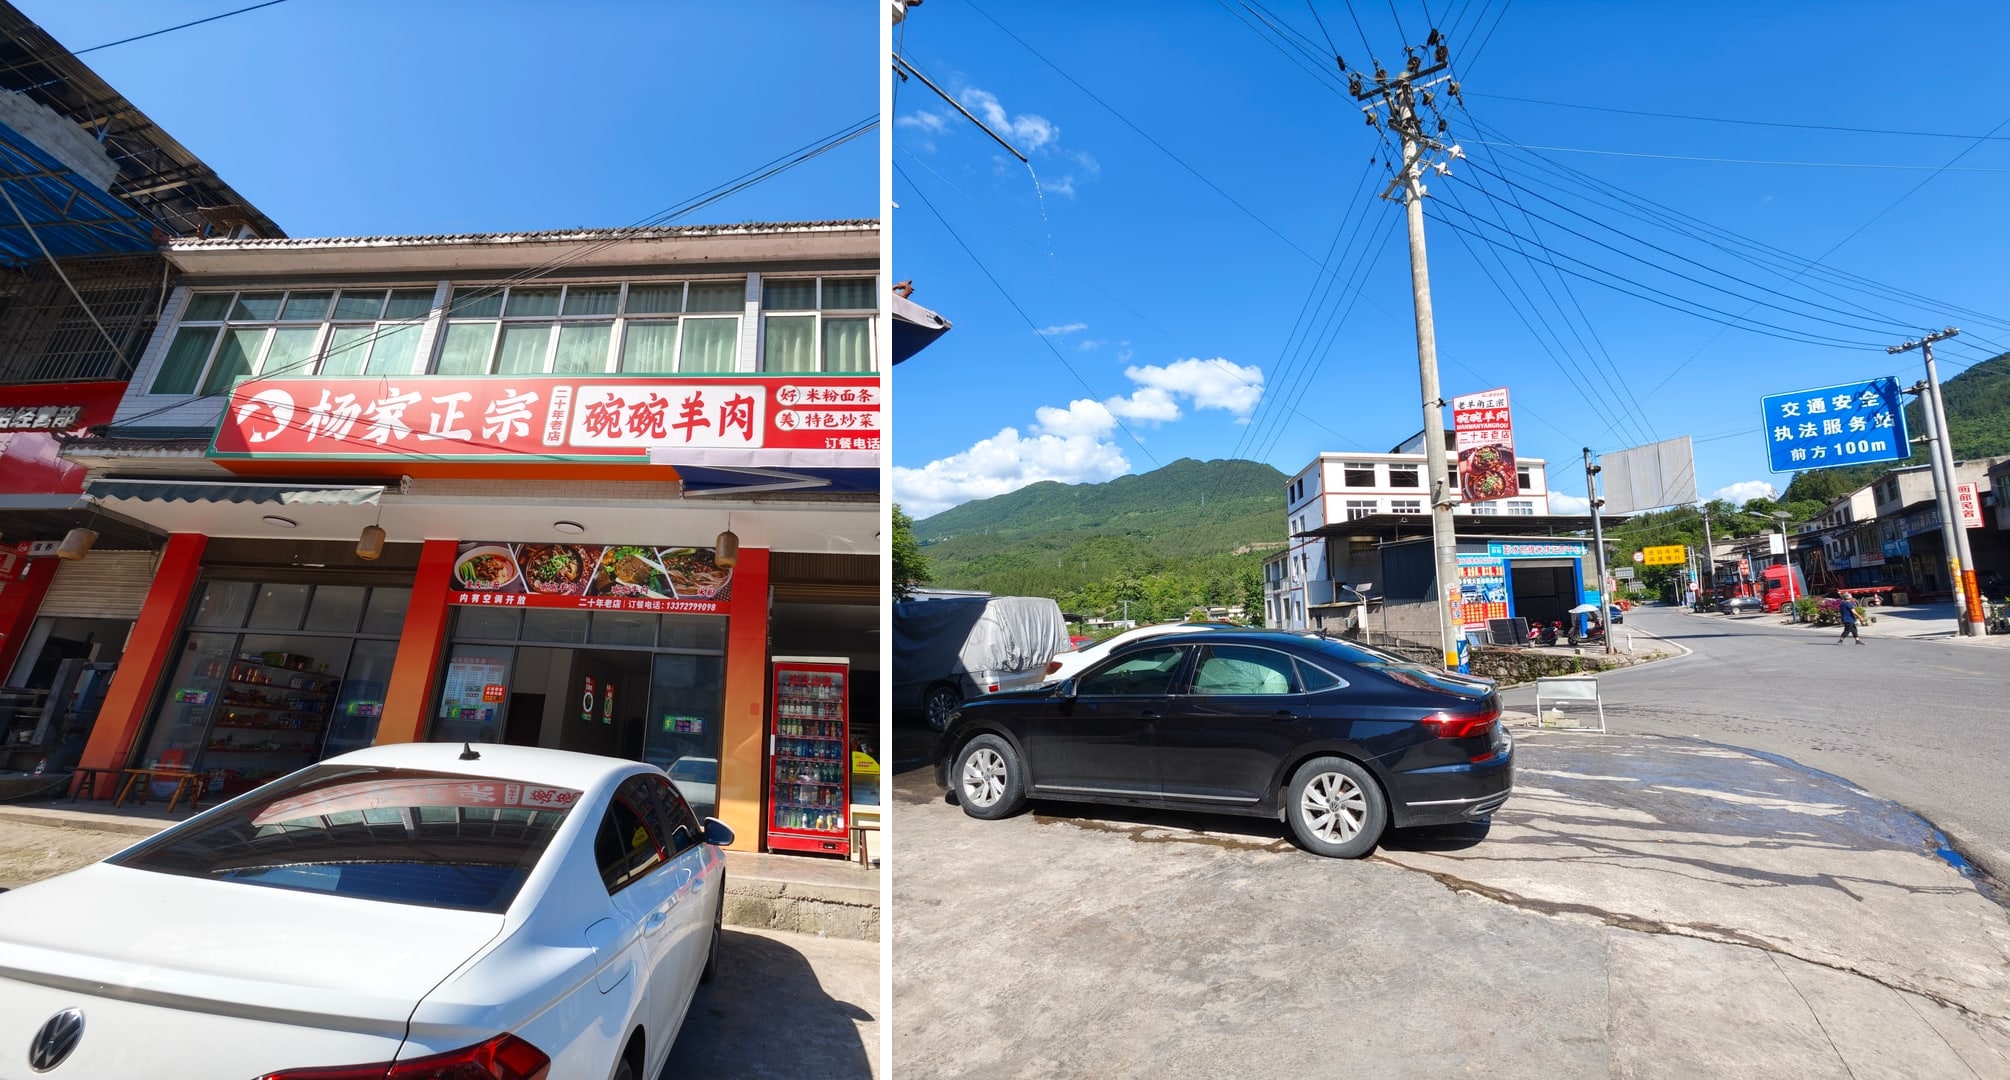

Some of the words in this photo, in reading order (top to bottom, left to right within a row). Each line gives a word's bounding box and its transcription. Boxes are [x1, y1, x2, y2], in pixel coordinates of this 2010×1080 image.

[806, 388, 875, 403] 米粉面条
[1781, 391, 1880, 418] 交通安全
[300, 387, 540, 446] 杨家正宗
[547, 389, 568, 442] 二十年老店
[582, 390, 756, 443] 碗碗羊肉
[804, 412, 876, 428] 特色炒菜
[1456, 410, 1509, 423] 碗碗羊肉
[1774, 412, 1896, 441] 执法服务站
[1459, 431, 1510, 442] 二十年老店
[1790, 446, 1827, 462] 前方
[1834, 440, 1887, 456] 100m
[459, 592, 528, 605] 内有空调开放
[578, 597, 622, 609] 二十年老店
